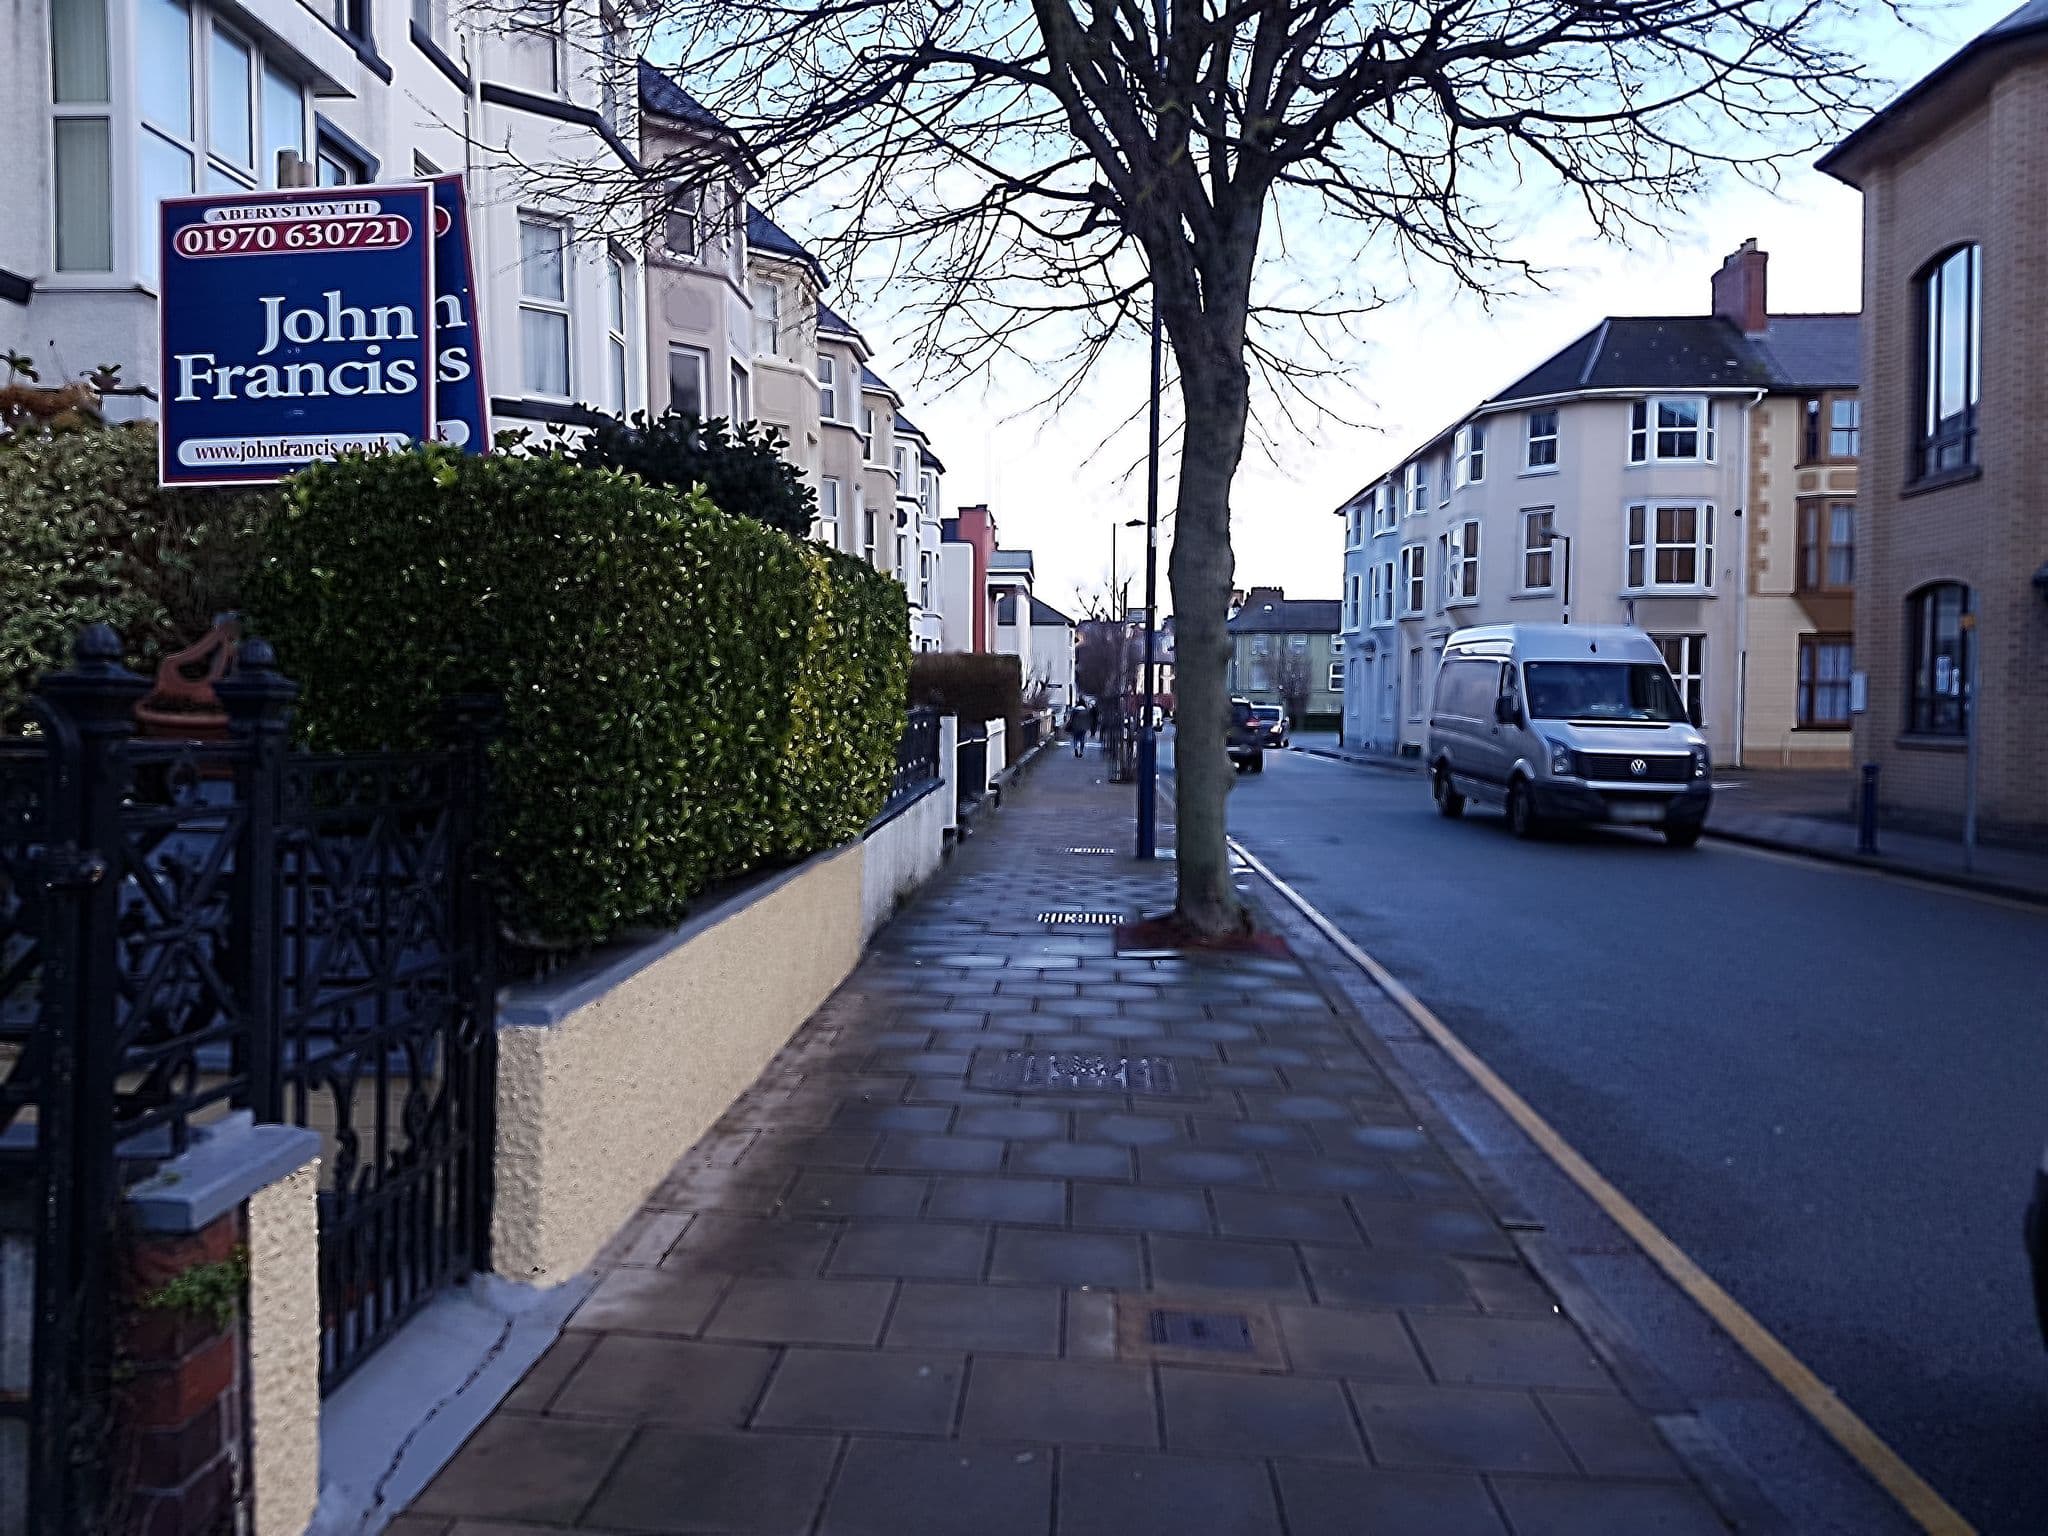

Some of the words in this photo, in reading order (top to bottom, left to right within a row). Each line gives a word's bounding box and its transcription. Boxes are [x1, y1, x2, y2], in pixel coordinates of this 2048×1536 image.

[215, 202, 370, 221] ABERYSTWYTH
[183, 225, 277, 253] 01970
[285, 220, 401, 248] 630721
[257, 290, 419, 356] John
[173, 344, 418, 401] Francis
[195, 436, 390, 462] www.johnfrancisco.uk
